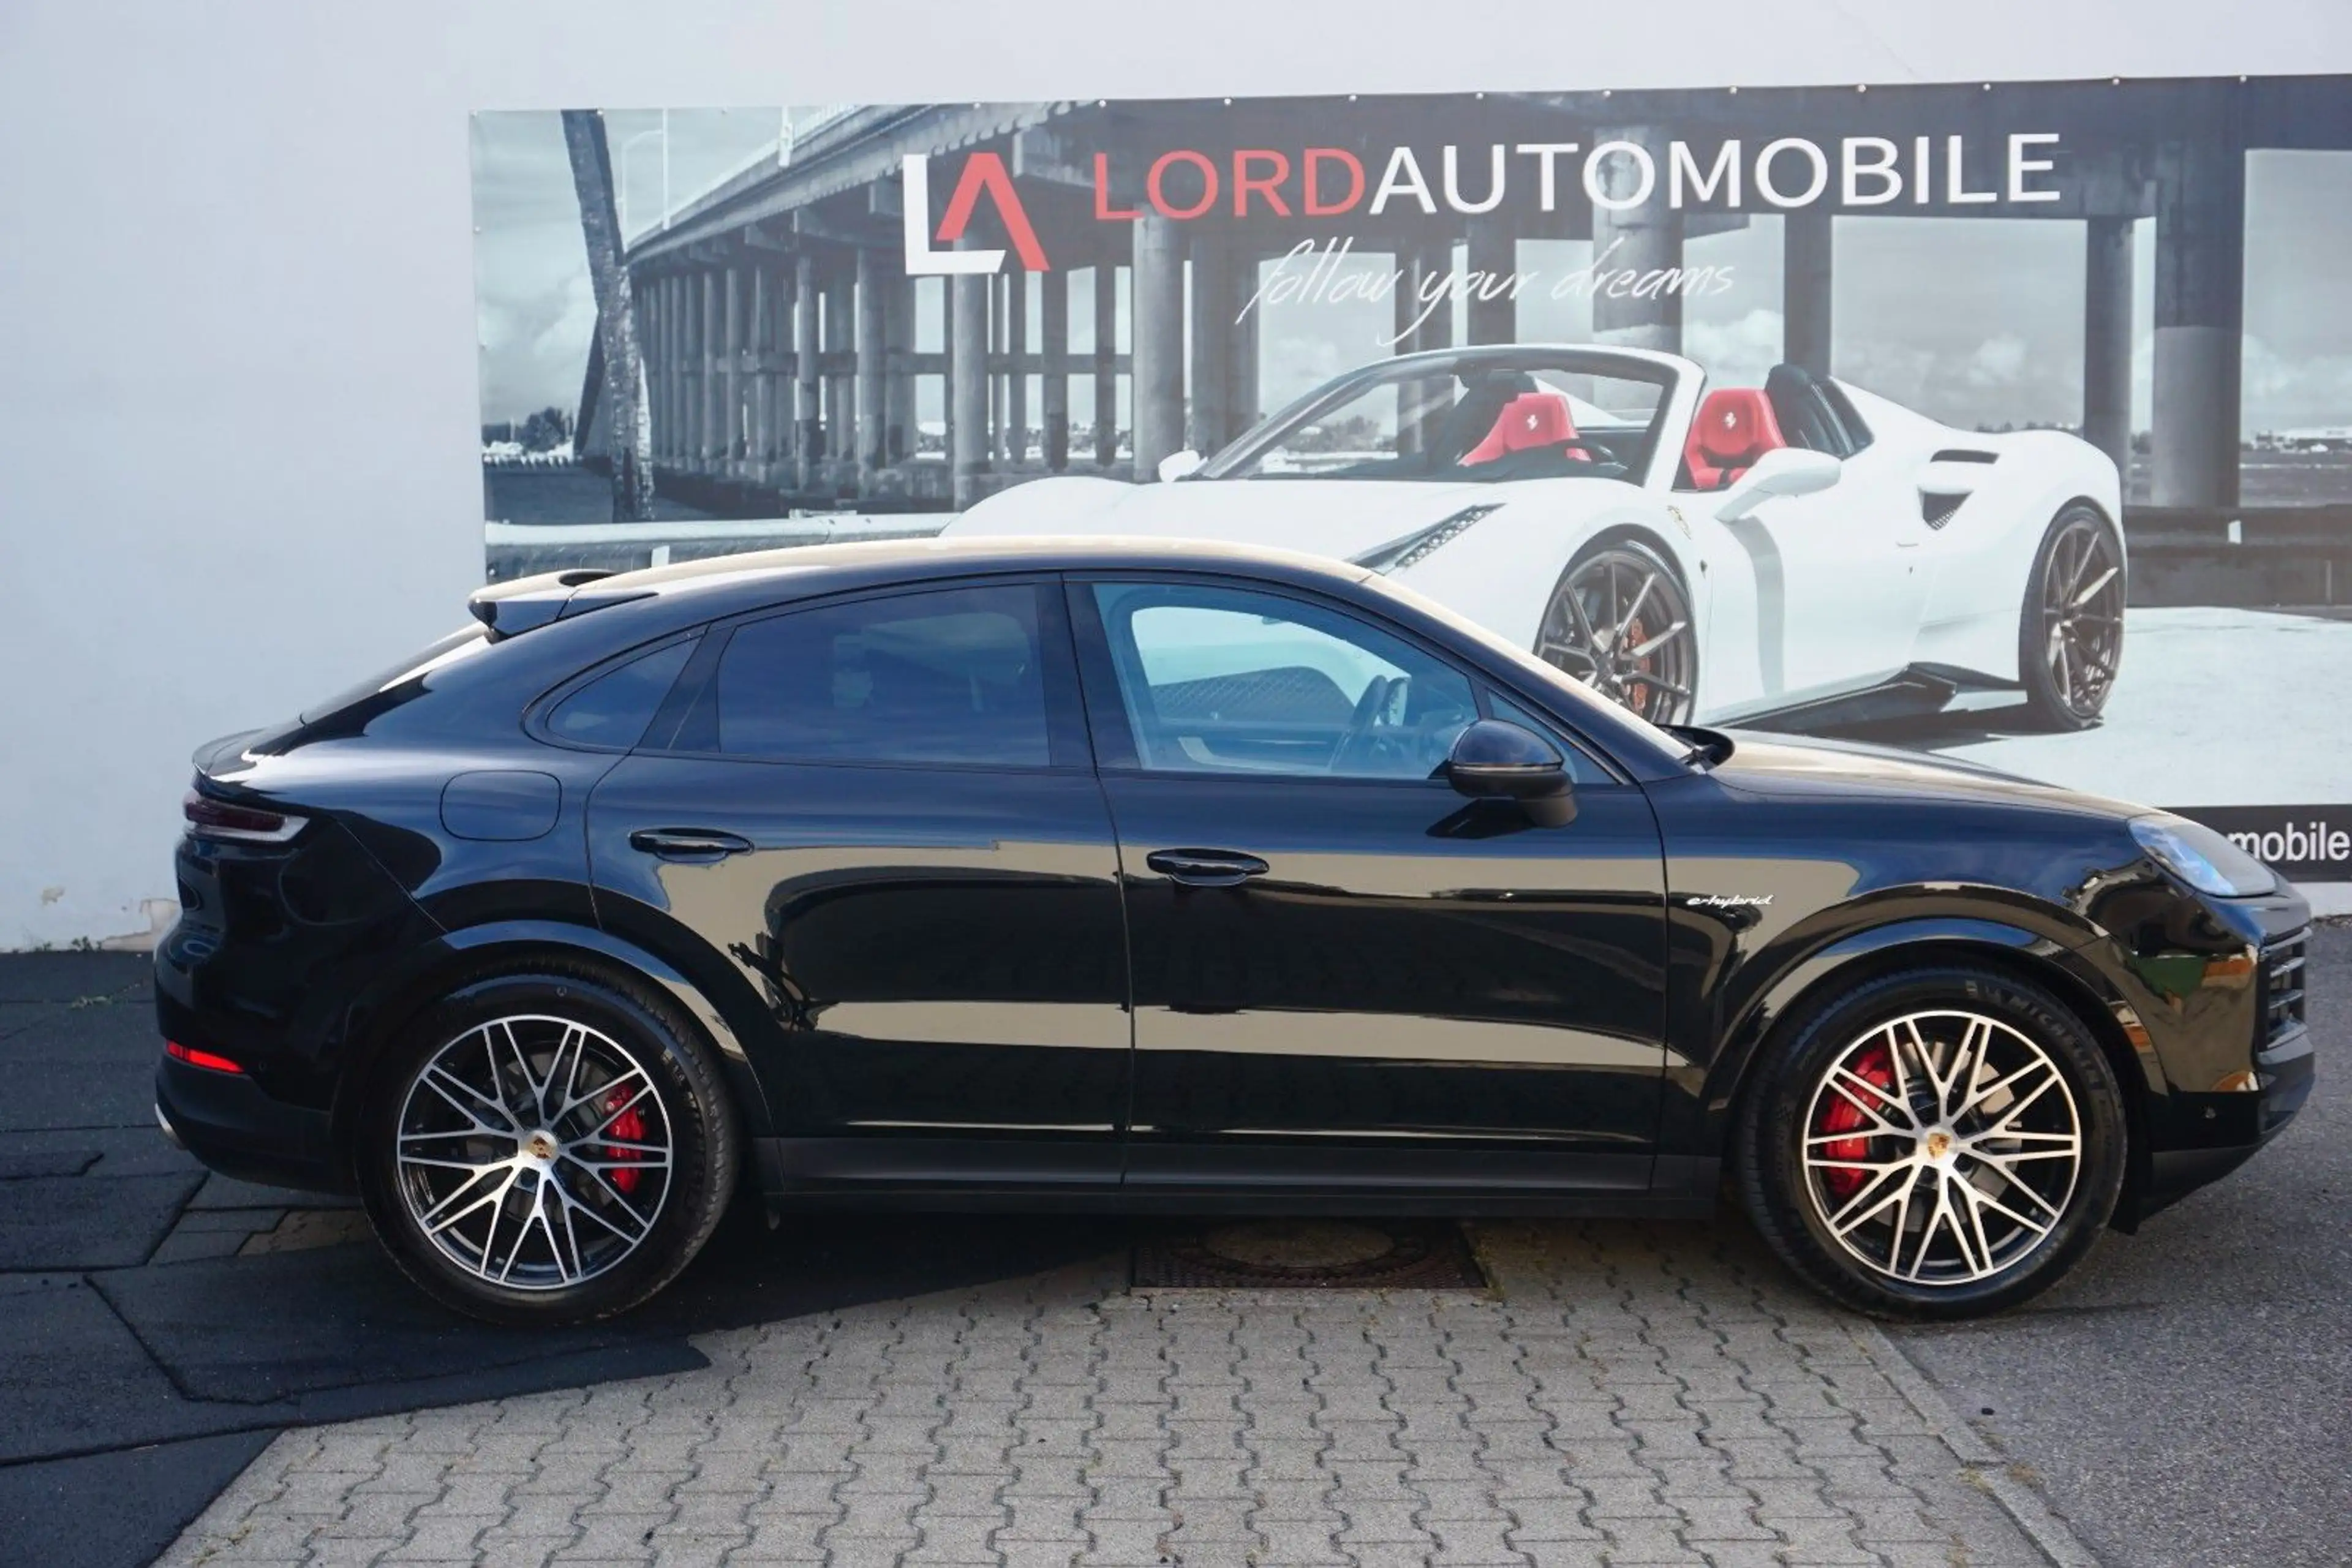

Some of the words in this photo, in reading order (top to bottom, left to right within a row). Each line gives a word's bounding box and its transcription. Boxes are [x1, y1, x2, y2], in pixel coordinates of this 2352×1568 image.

[1094, 133, 2060, 221] LORDAUTOMOBILE
[1235, 237, 1404, 325] follow
[1376, 260, 1540, 346] your
[1551, 238, 1735, 300] dreams
